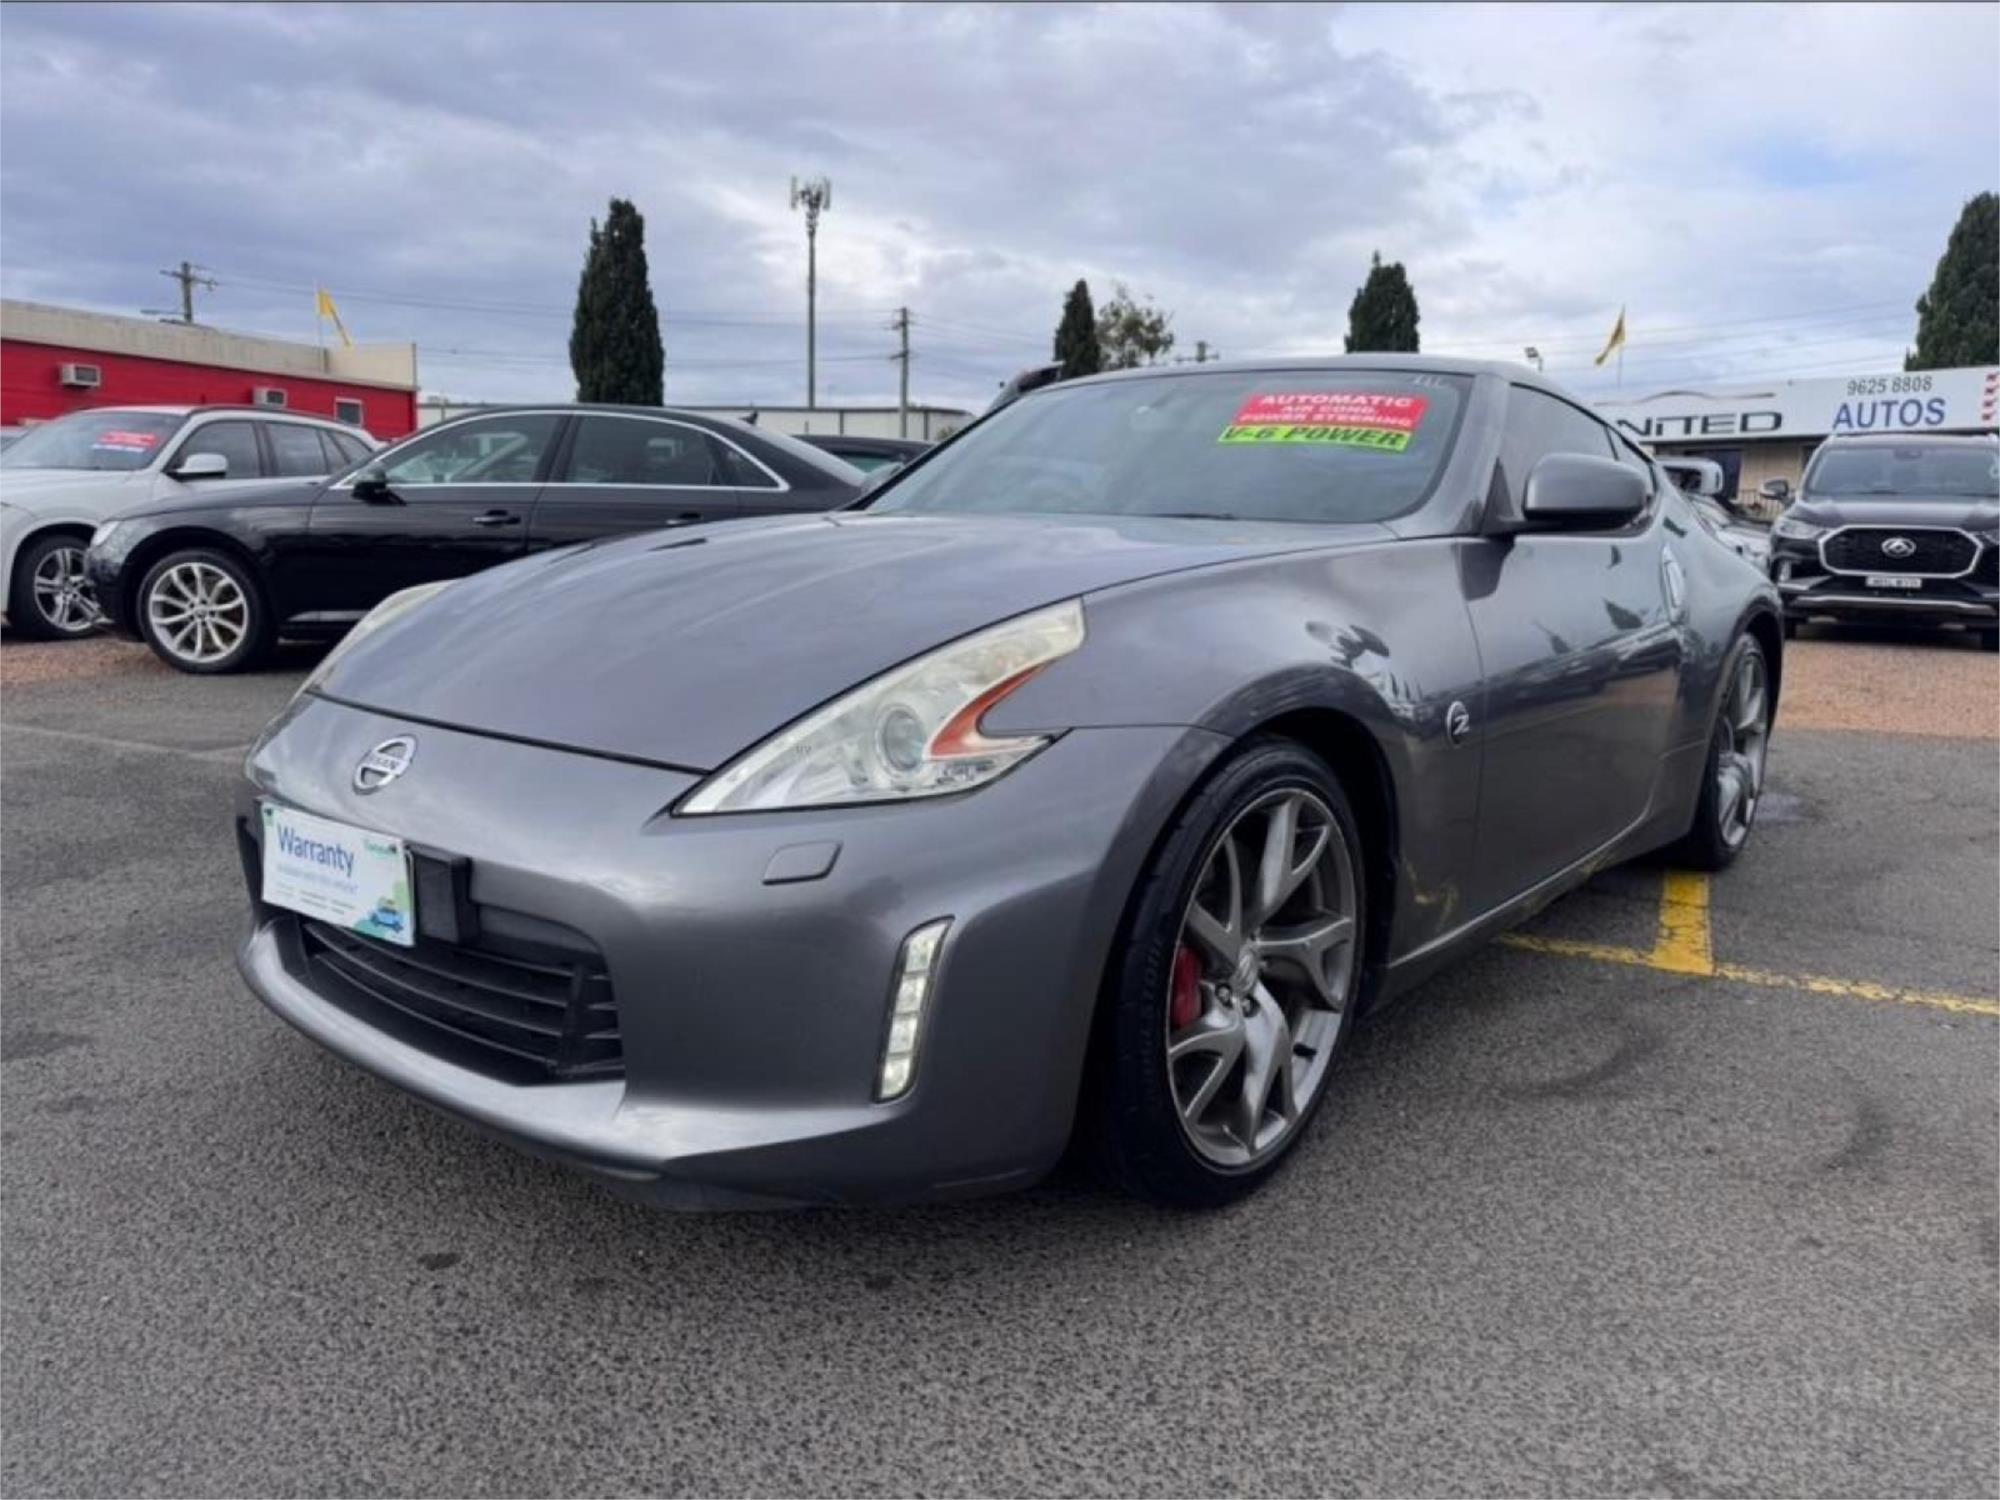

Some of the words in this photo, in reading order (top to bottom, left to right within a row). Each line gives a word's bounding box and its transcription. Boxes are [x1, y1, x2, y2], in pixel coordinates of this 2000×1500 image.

[1847, 378, 1887, 396] 9625
[1259, 394, 1412, 408] AUTOMATIC
[1279, 405, 1313, 414] AIR
[1239, 413, 1310, 422] POWER
[1312, 413, 1412, 427] STEERING
[1832, 398, 1946, 430] AUTOS
[1616, 411, 1783, 437] NITED
[1225, 427, 1276, 439] V-6
[1283, 427, 1405, 446] POWER
[277, 824, 355, 877] Warranty
